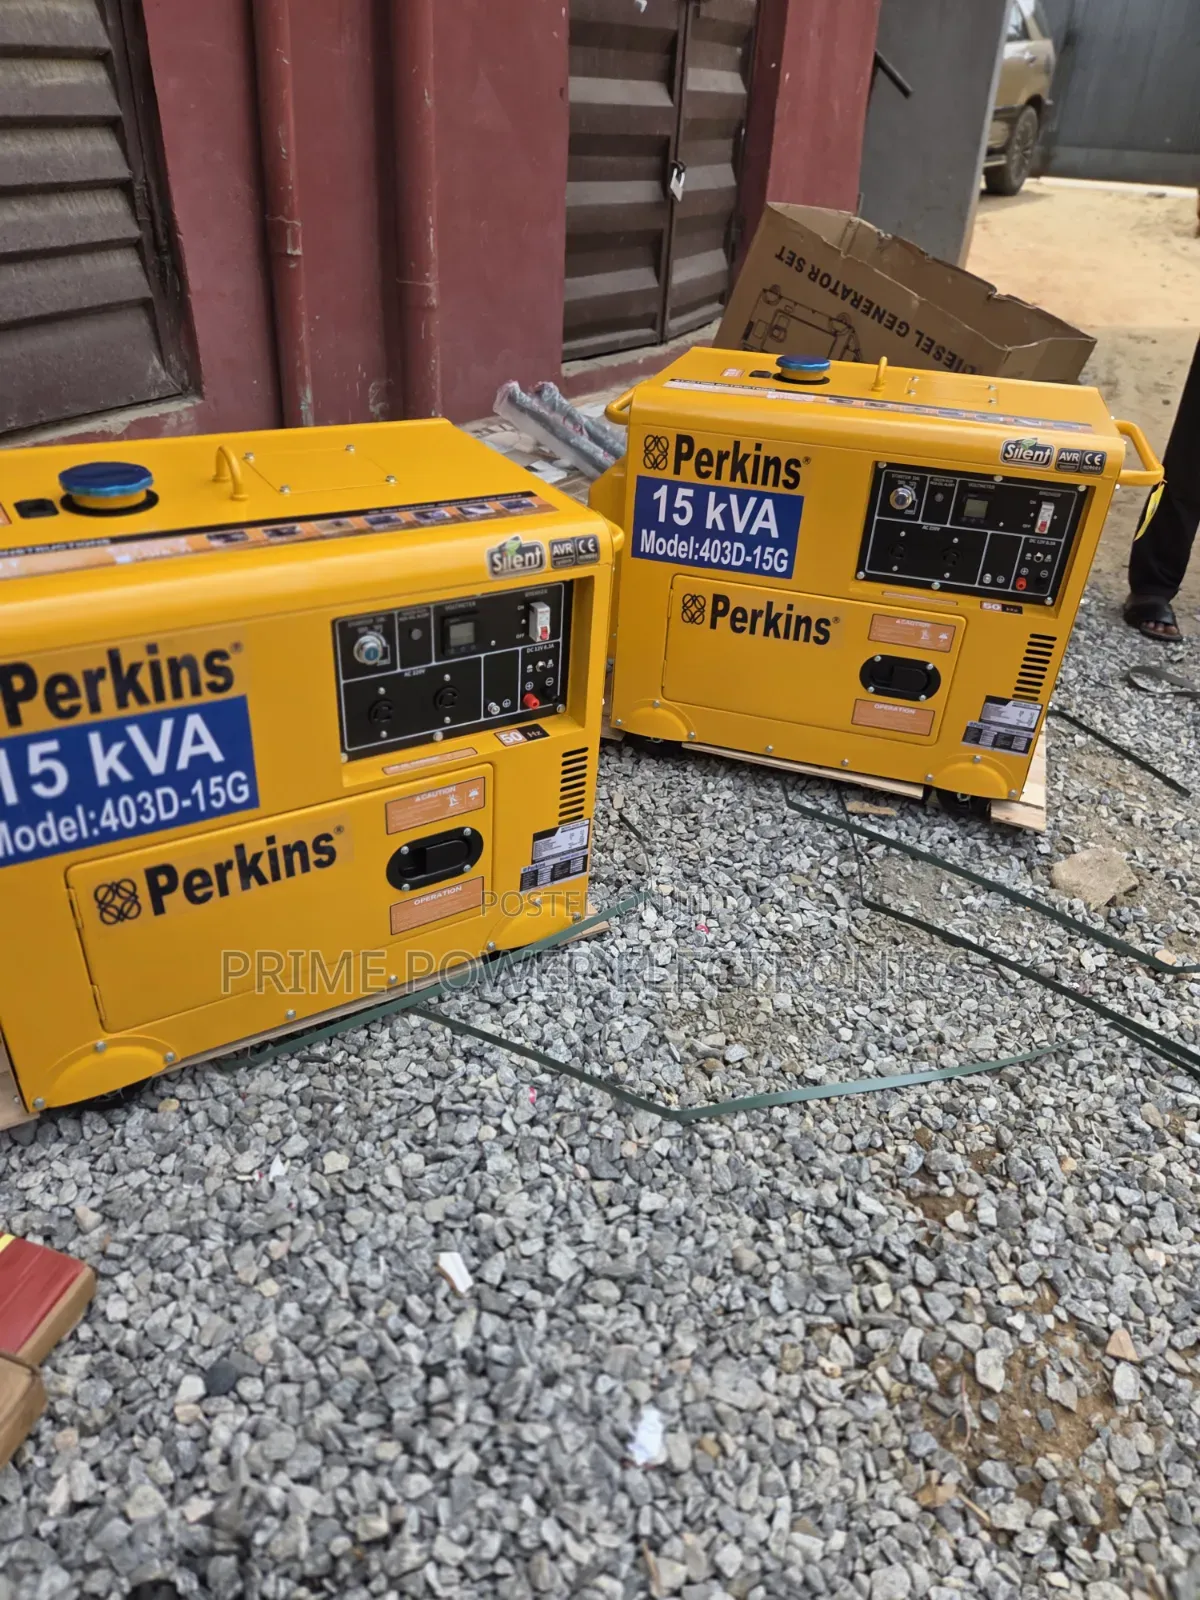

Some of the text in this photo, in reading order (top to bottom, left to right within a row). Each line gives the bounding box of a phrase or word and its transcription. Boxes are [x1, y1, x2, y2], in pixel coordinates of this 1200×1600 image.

[774, 245, 805, 273] SET
[807, 267, 909, 338] GENERATOR
[1004, 444, 1051, 463] Silent
[1059, 451, 1079, 462] AVR
[1084, 453, 1103, 465] CE
[653, 485, 779, 538] 15 kVA
[552, 543, 574, 556] AVR
[578, 539, 596, 554] CE
[640, 529, 789, 573] Model:403D-15G
[493, 546, 542, 572] Silent
[983, 602, 1002, 611] 50
[874, 703, 917, 716] OPERATION
[500, 731, 523, 743] 50
[0, 713, 225, 806] 15 kVA
[421, 784, 457, 800] CAUTION
[413, 885, 463, 905] OPERATION
